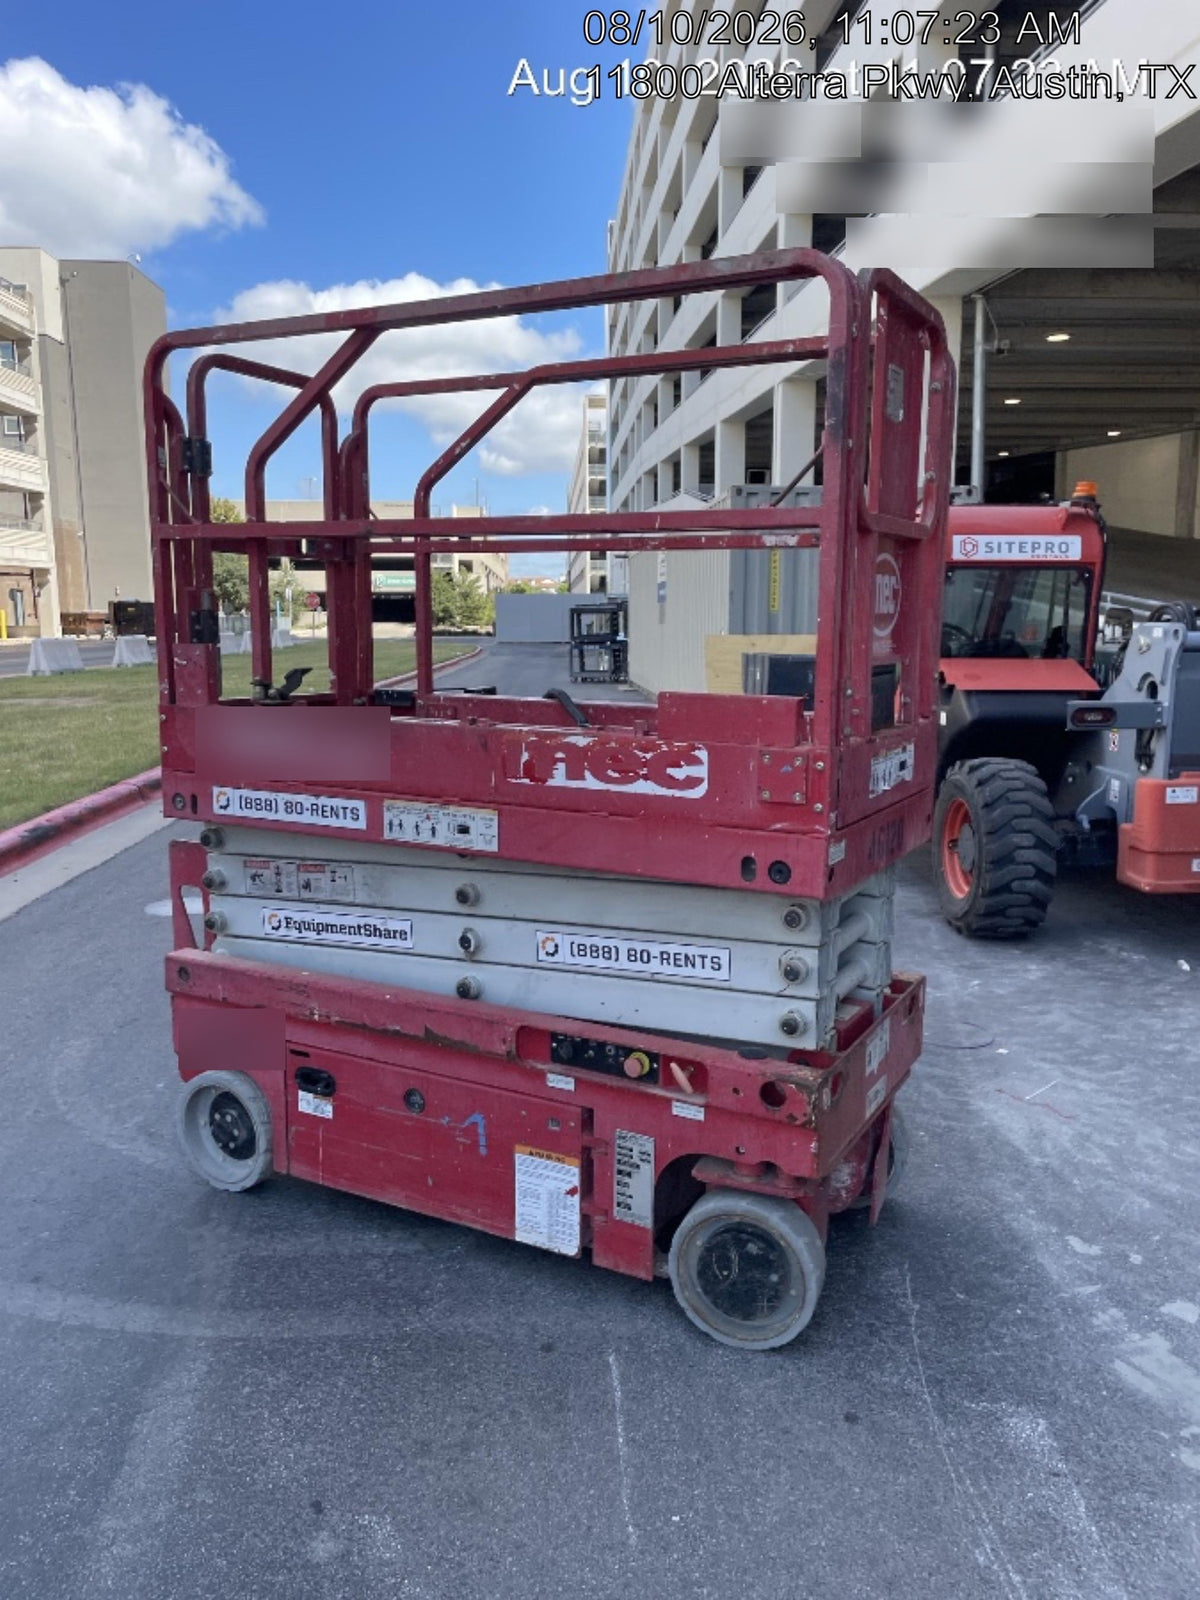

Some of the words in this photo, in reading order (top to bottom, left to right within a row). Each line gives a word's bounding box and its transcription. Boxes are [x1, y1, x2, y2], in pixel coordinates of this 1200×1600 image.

[984, 541, 1070, 554] SITEPRO
[239, 794, 278, 814] (888)
[284, 801, 360, 821] 80-RENTS
[284, 916, 408, 941] EquipmentShare
[570, 941, 619, 962] (888)
[627, 948, 722, 971] 80-RENTS
